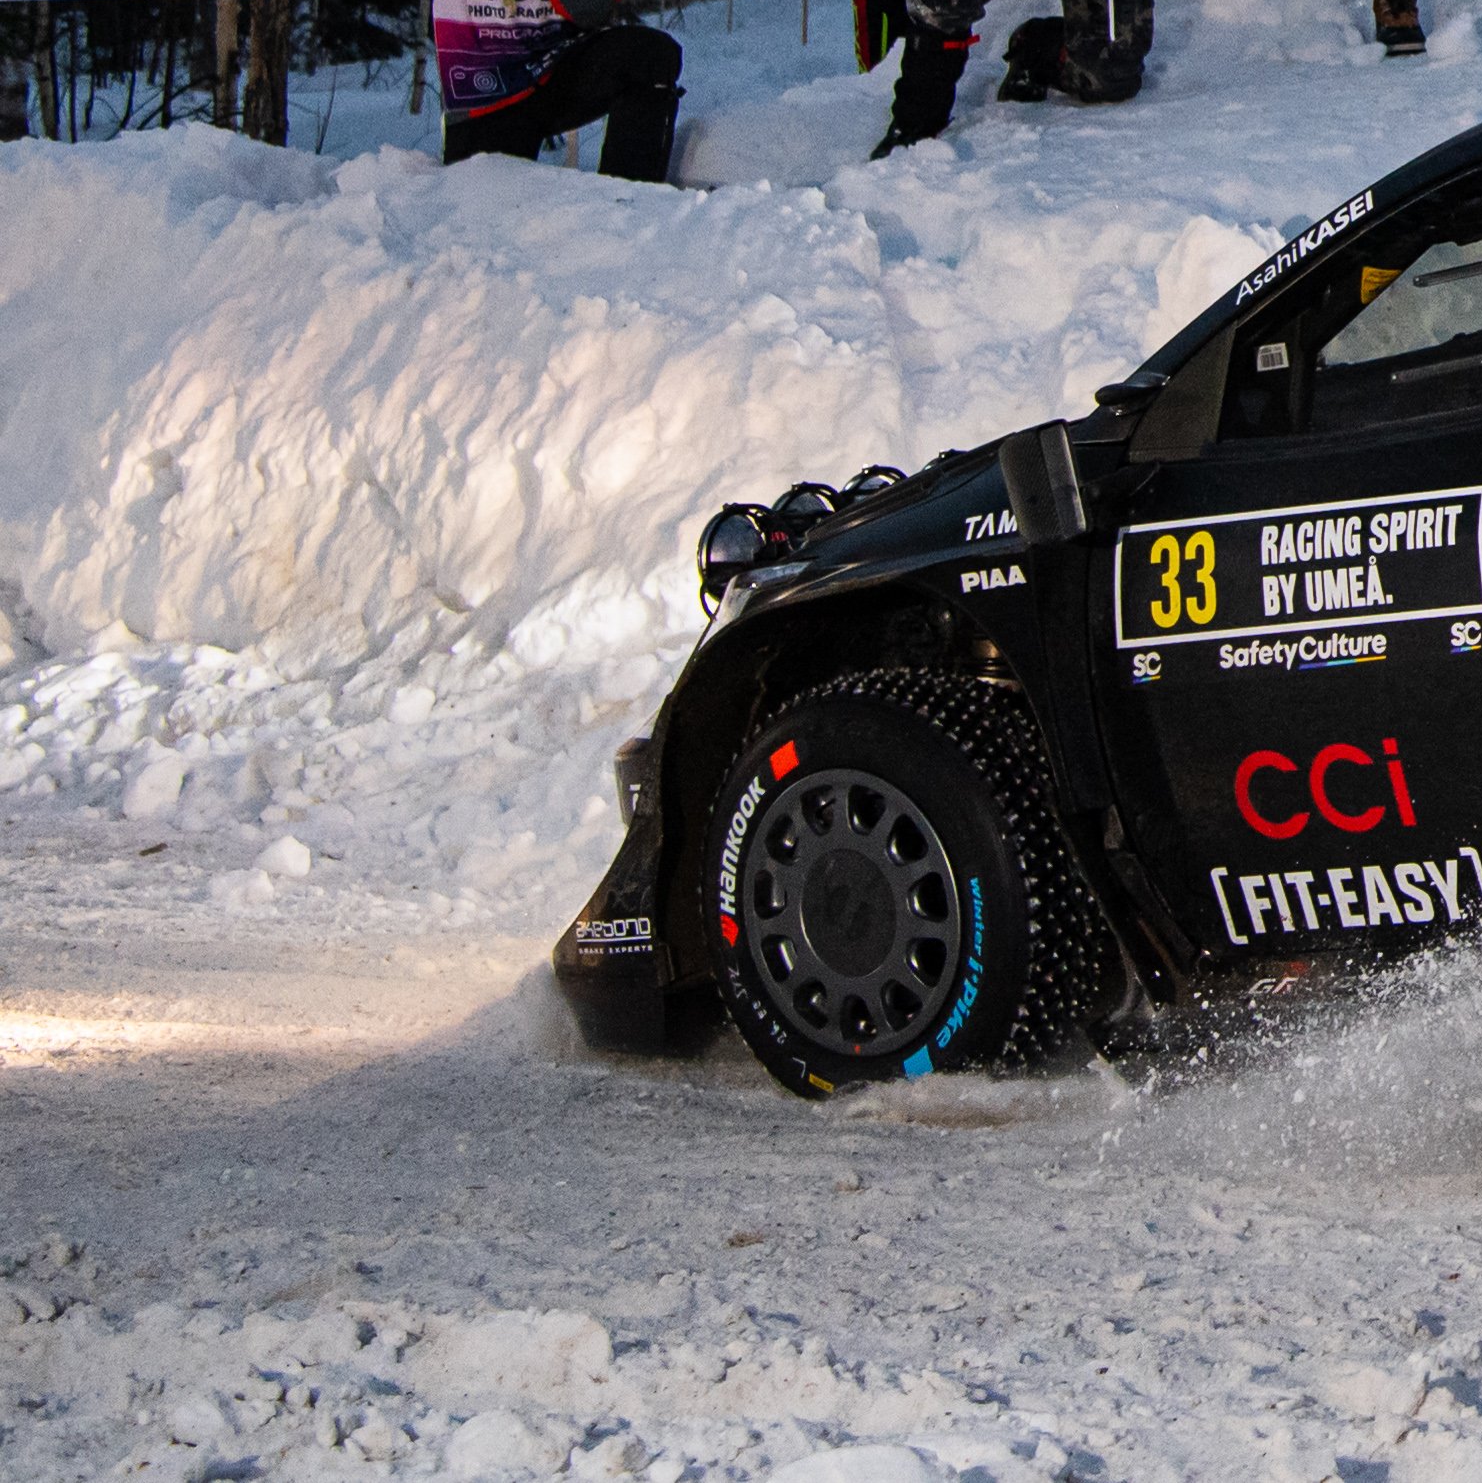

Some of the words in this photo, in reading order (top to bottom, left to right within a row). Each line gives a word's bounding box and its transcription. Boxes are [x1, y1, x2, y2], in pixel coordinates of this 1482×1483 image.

[1236, 190, 1374, 305] AsahiKASEI
[965, 509, 1018, 541] TAM
[1260, 514, 1361, 566] RACING
[1368, 504, 1464, 552] SPIRIT
[961, 565, 1027, 593] PIAA
[1150, 530, 1217, 628] 33
[1262, 572, 1297, 618] BY
[1219, 631, 1387, 670] SafetyCulture
[1451, 621, 1482, 648] SC
[1132, 651, 1162, 678] SC
